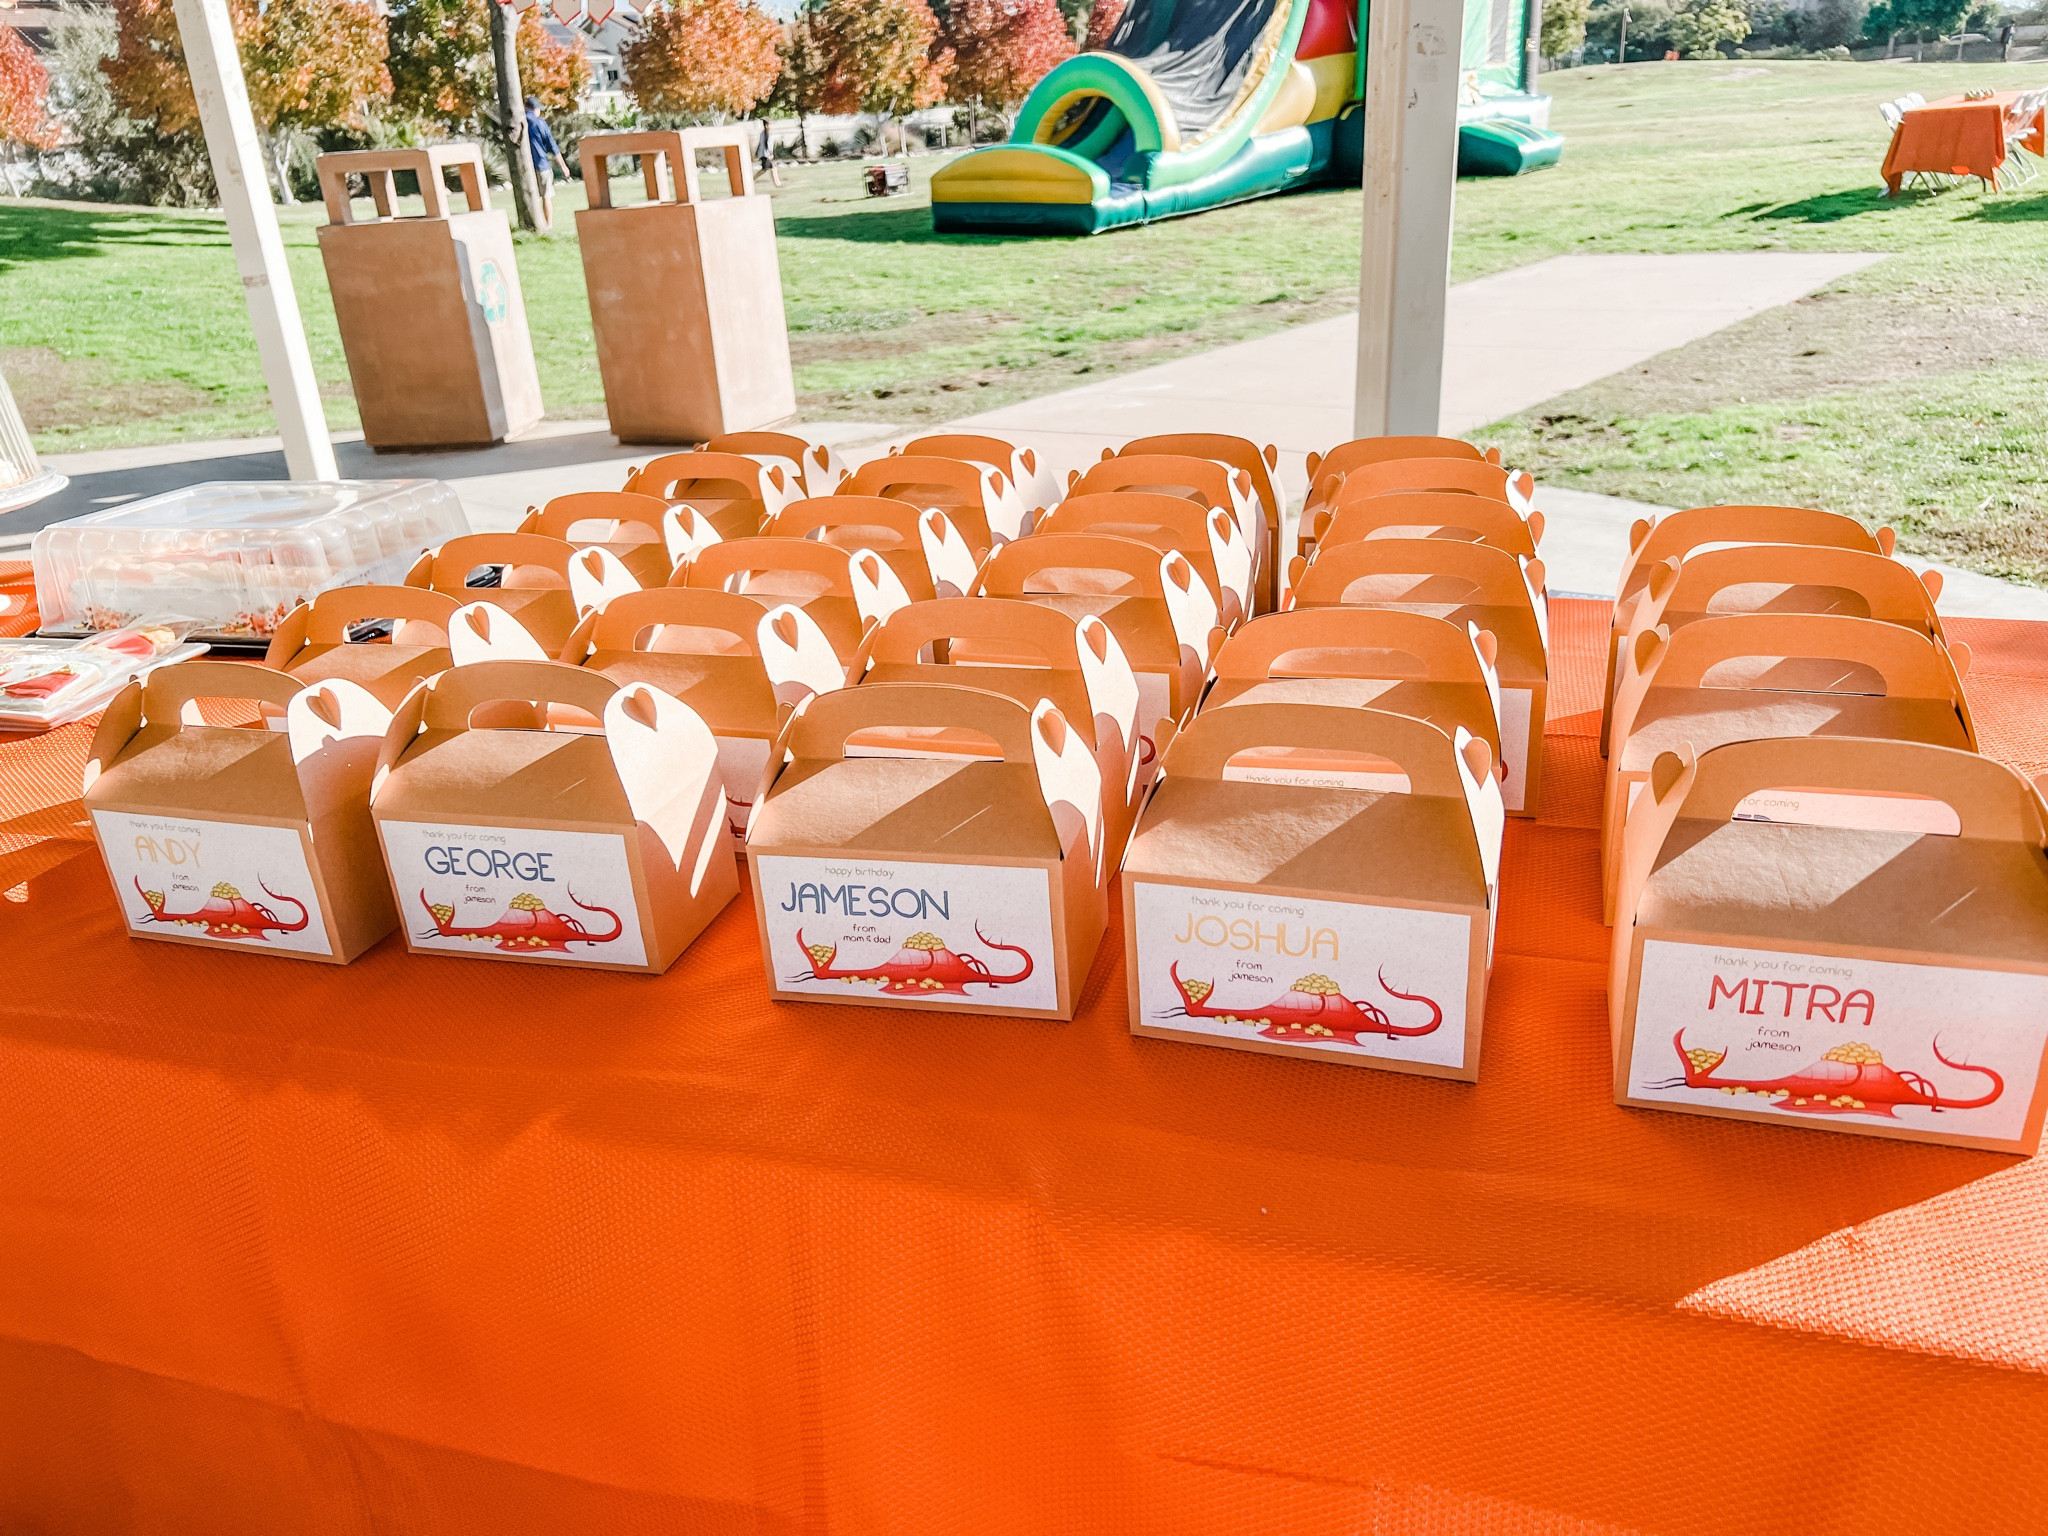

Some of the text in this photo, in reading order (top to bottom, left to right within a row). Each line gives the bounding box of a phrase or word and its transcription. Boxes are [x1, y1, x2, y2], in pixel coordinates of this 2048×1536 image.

[1246, 774, 1271, 784] thank
[1294, 776, 1308, 785] for
[1312, 778, 1344, 787] coming
[1764, 799, 1800, 811] coming
[129, 820, 201, 836] thank you for coming
[422, 830, 506, 845] thank you for coming
[134, 835, 201, 867] ANDY
[424, 846, 556, 882] GEORGE
[172, 872, 189, 881] from
[825, 866, 895, 879] happy birthday
[171, 883, 199, 892] jameson
[466, 884, 486, 893] from
[464, 895, 496, 905] jameson
[781, 882, 949, 920] JAMESON
[1191, 895, 1305, 918] thank you for coming
[853, 924, 876, 933] from
[873, 935, 892, 944] dad
[1175, 913, 1339, 961] JOSHUA
[1236, 959, 1263, 971] from
[1714, 954, 1853, 979] thank you for coming
[1228, 970, 1274, 984] jameson
[1708, 974, 1875, 1026] MITRA
[1758, 1026, 1790, 1039] from
[1745, 1039, 1801, 1053] jameson
